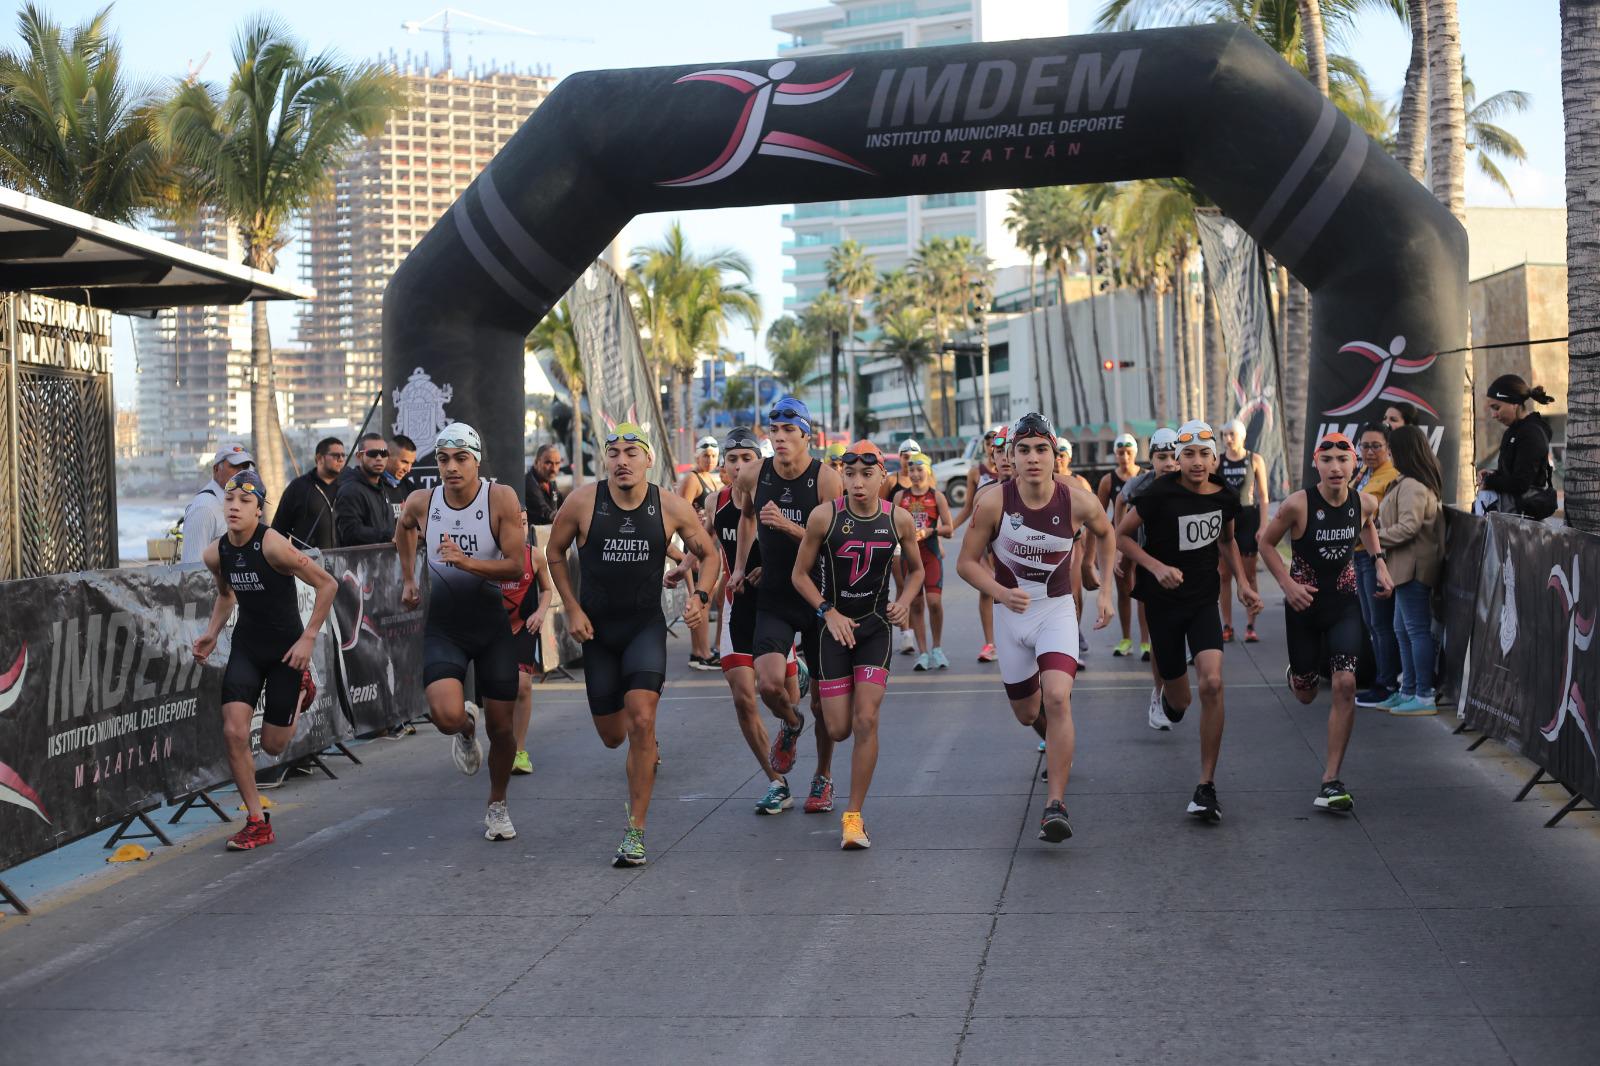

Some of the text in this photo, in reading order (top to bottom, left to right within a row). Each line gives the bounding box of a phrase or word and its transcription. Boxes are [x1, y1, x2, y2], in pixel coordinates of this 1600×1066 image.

[867, 48, 1143, 128] IMDEM
[866, 115, 1125, 148] INSTITUTO MUNICIPAL DEL DEPORTE
[911, 140, 1081, 168] MAZATLÁN
[20, 291, 112, 336] RESTAURANTE
[22, 332, 113, 374] PLAYA NORTE
[440, 533, 478, 552] TCH
[1186, 515, 1221, 544] 008
[1316, 525, 1355, 541] CALDERÓN
[602, 550, 650, 562] MAZATLÁN
[603, 538, 650, 551] ZAZUETA
[230, 572, 259, 583] VALLEJO
[47, 697, 198, 759] INSTITUTO MUNICIPAL DEL DEPORTE
